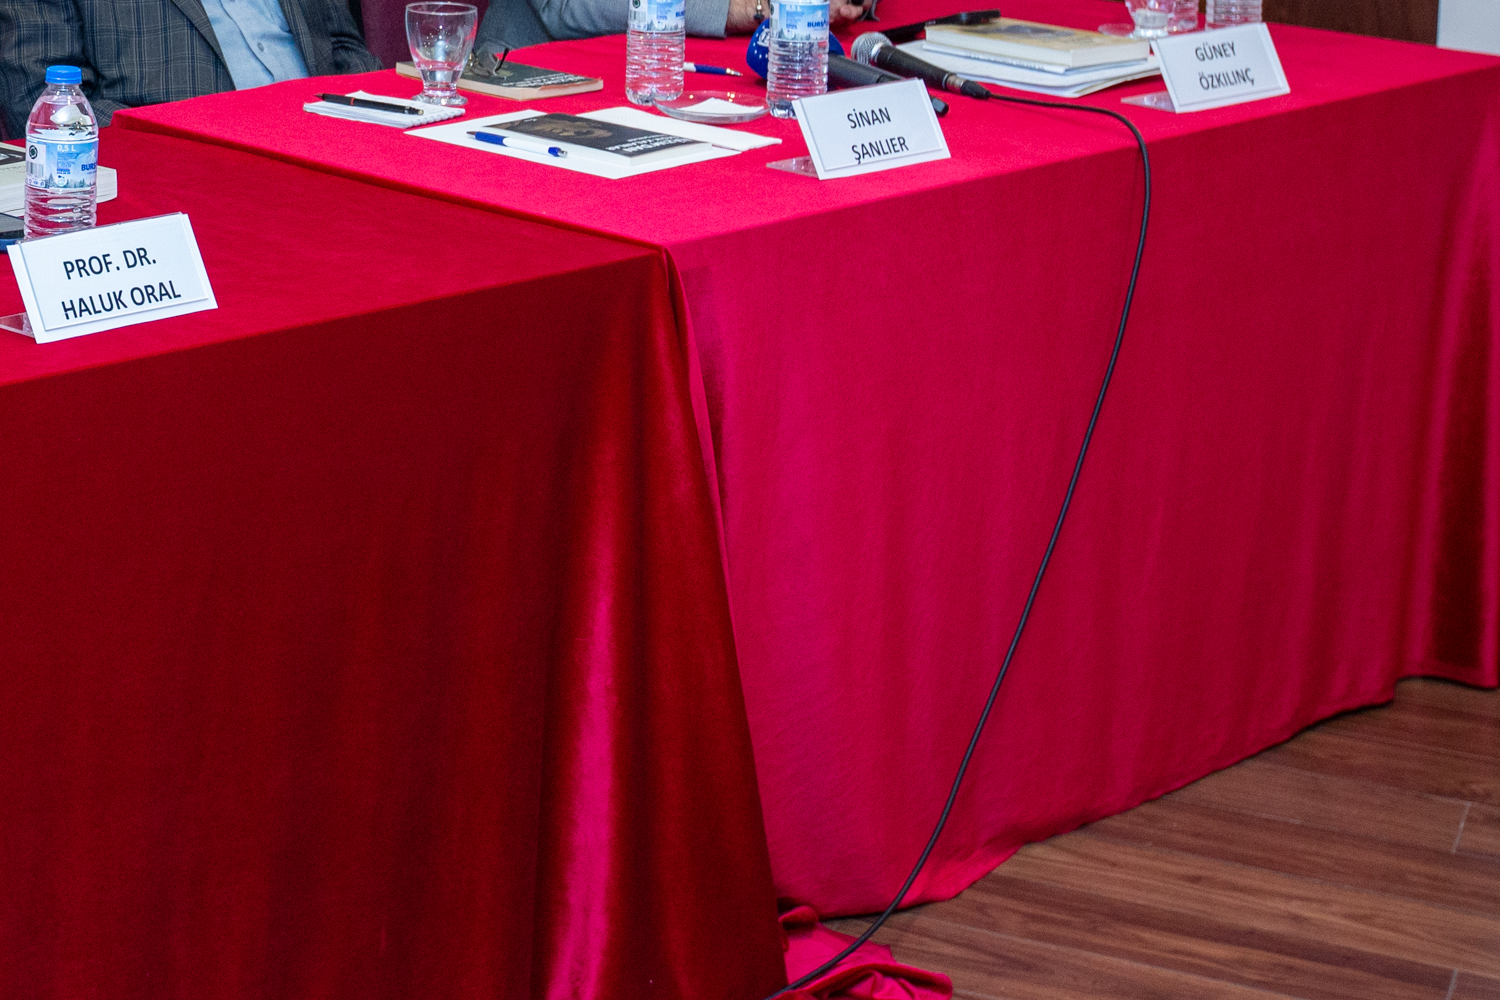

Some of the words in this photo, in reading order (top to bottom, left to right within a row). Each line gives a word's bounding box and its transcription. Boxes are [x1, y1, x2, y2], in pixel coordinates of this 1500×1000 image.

[1195, 41, 1236, 62] GÜNEY
[1198, 66, 1255, 90] ÖZKILINÇ
[846, 107, 892, 130] SİNAN
[851, 136, 910, 166] ŞANLIER
[62, 253, 120, 280] PROF.
[122, 247, 157, 269] DR.
[61, 289, 128, 320] HALUK
[130, 280, 182, 306] ORAL
